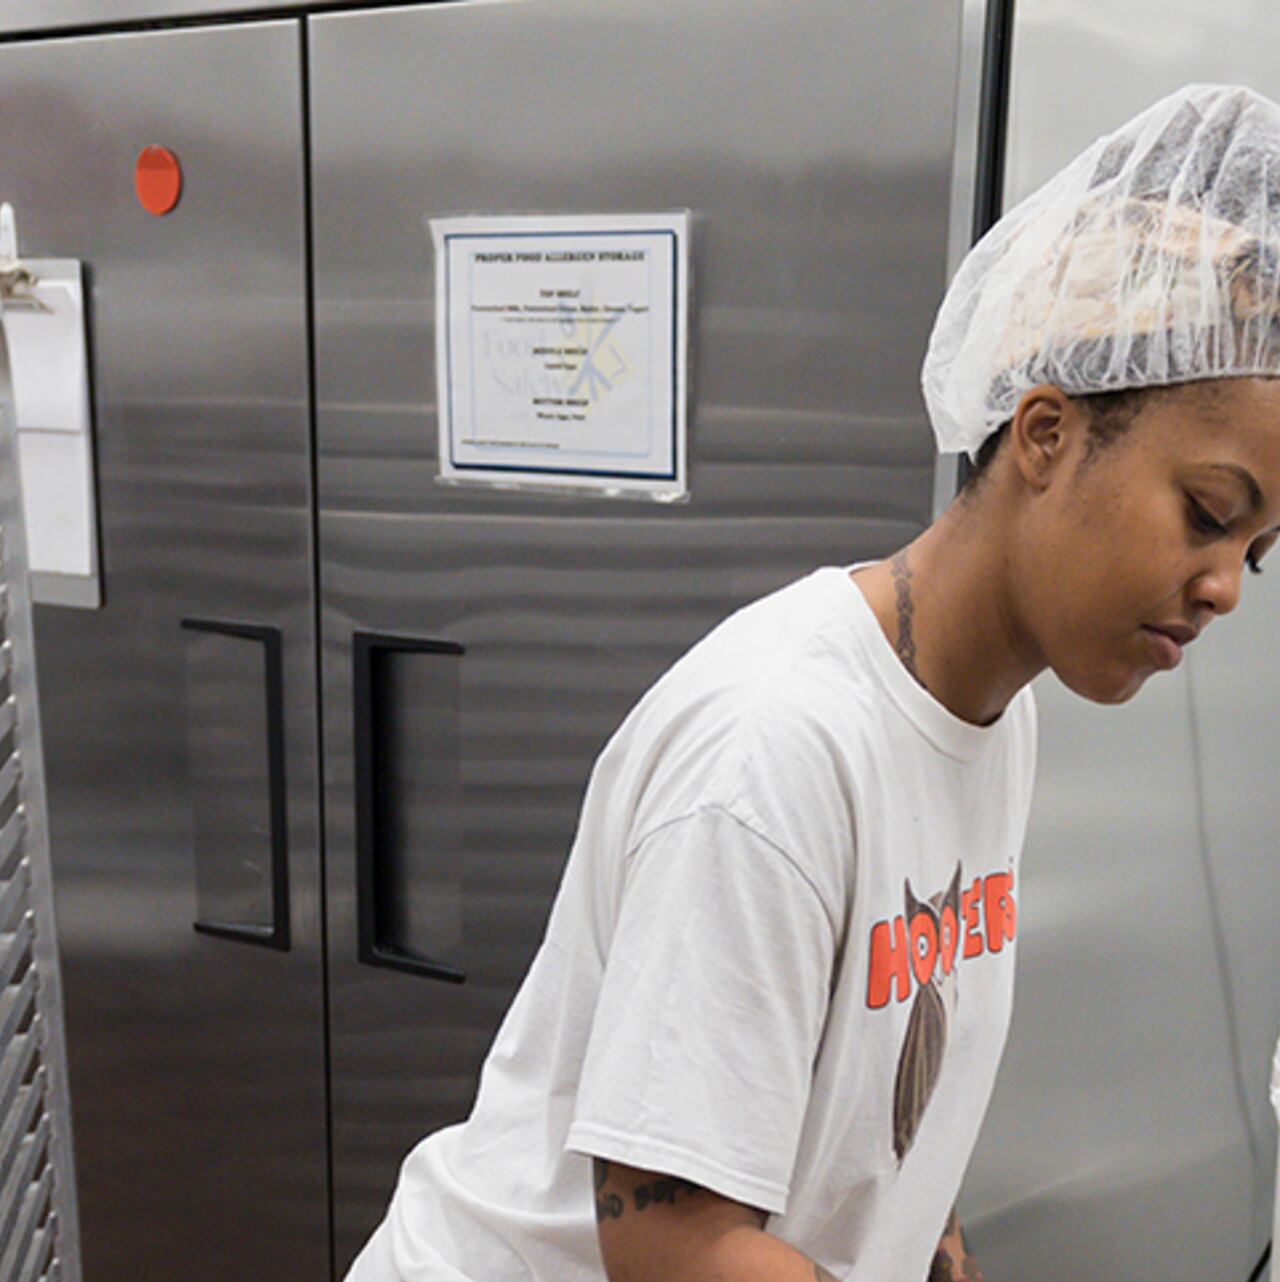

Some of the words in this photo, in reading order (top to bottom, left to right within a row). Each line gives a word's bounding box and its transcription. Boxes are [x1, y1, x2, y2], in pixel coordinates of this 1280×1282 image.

[475, 252, 512, 262] PROPER
[516, 252, 542, 262] FOOD
[545, 252, 595, 262] ALLERGEN
[598, 252, 645, 262] STORAGE
